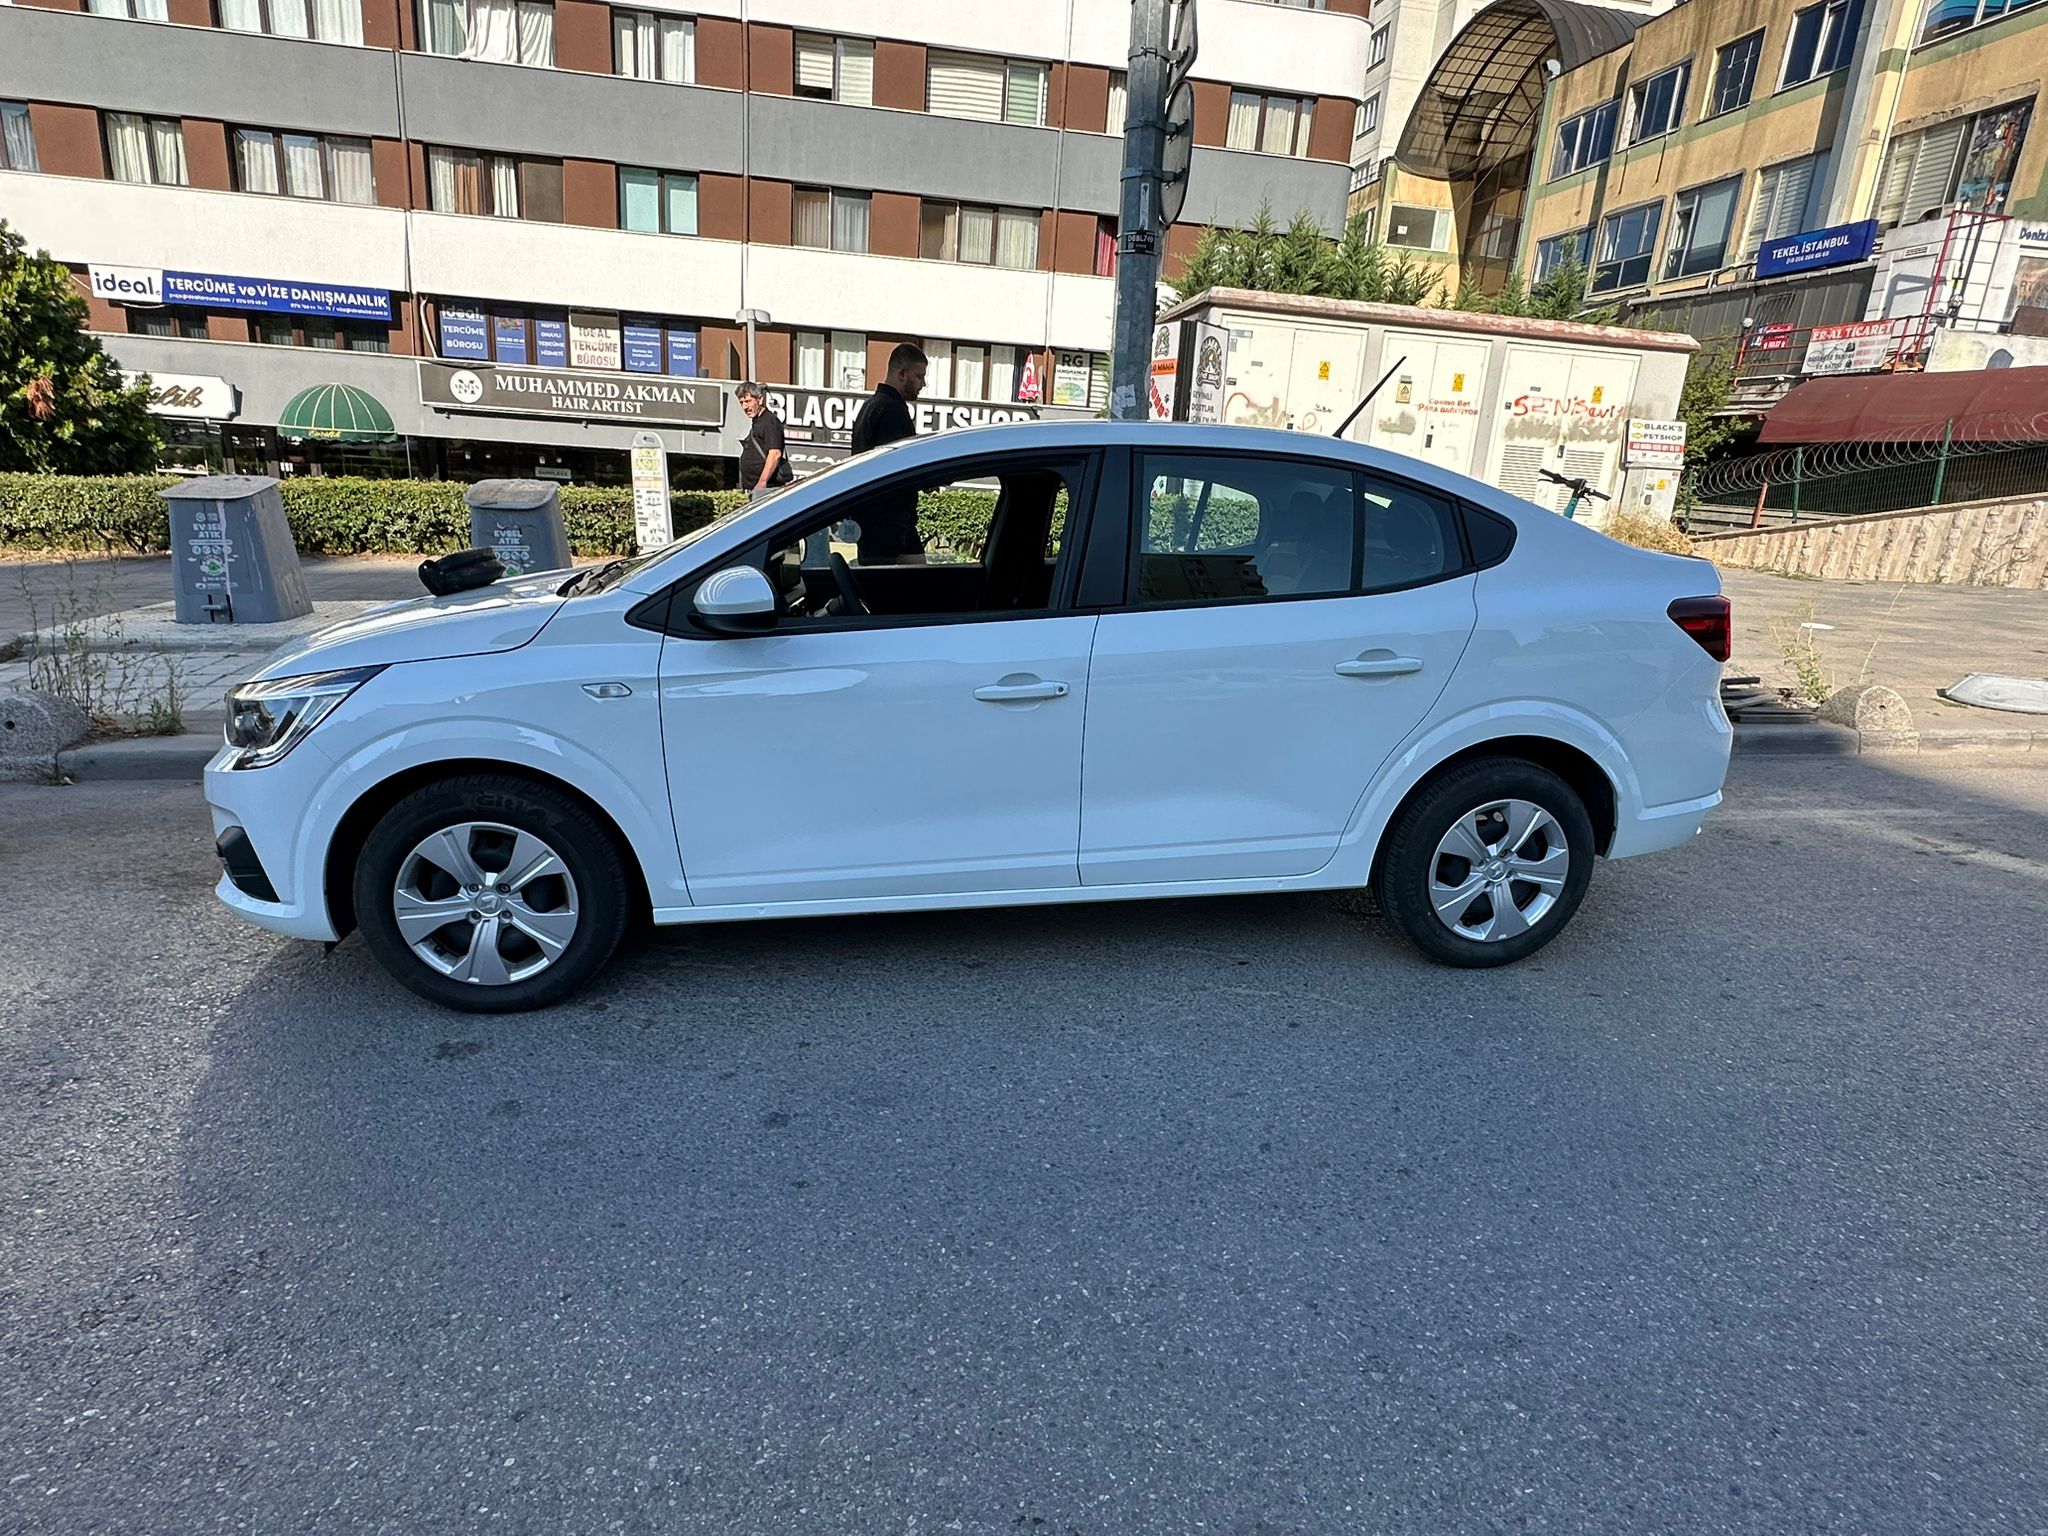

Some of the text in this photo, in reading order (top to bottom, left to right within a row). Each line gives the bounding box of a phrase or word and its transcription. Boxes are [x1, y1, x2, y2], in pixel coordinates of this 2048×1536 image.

[1772, 246, 1799, 260] TEKEL
[1802, 235, 1850, 254] İSTANBUL
[166, 277, 388, 308] TERCÜME ve VİZE DANIŞMANLIK
[442, 325, 485, 336] TERCÜME
[1845, 322, 1894, 338] TİCARET
[446, 338, 483, 350] BÜROSU
[572, 338, 618, 353] TERCÜME
[576, 354, 616, 367] BÜROSU
[1062, 353, 1084, 367] RG
[495, 374, 696, 405] MUHAMMED AKMAN
[551, 396, 643, 414] HAIR ARTIST
[1644, 423, 1684, 432] BLACK'S
[1643, 433, 1683, 441] PETSHOP
[198, 531, 221, 539] ATIK
[499, 537, 520, 545] ATIK
